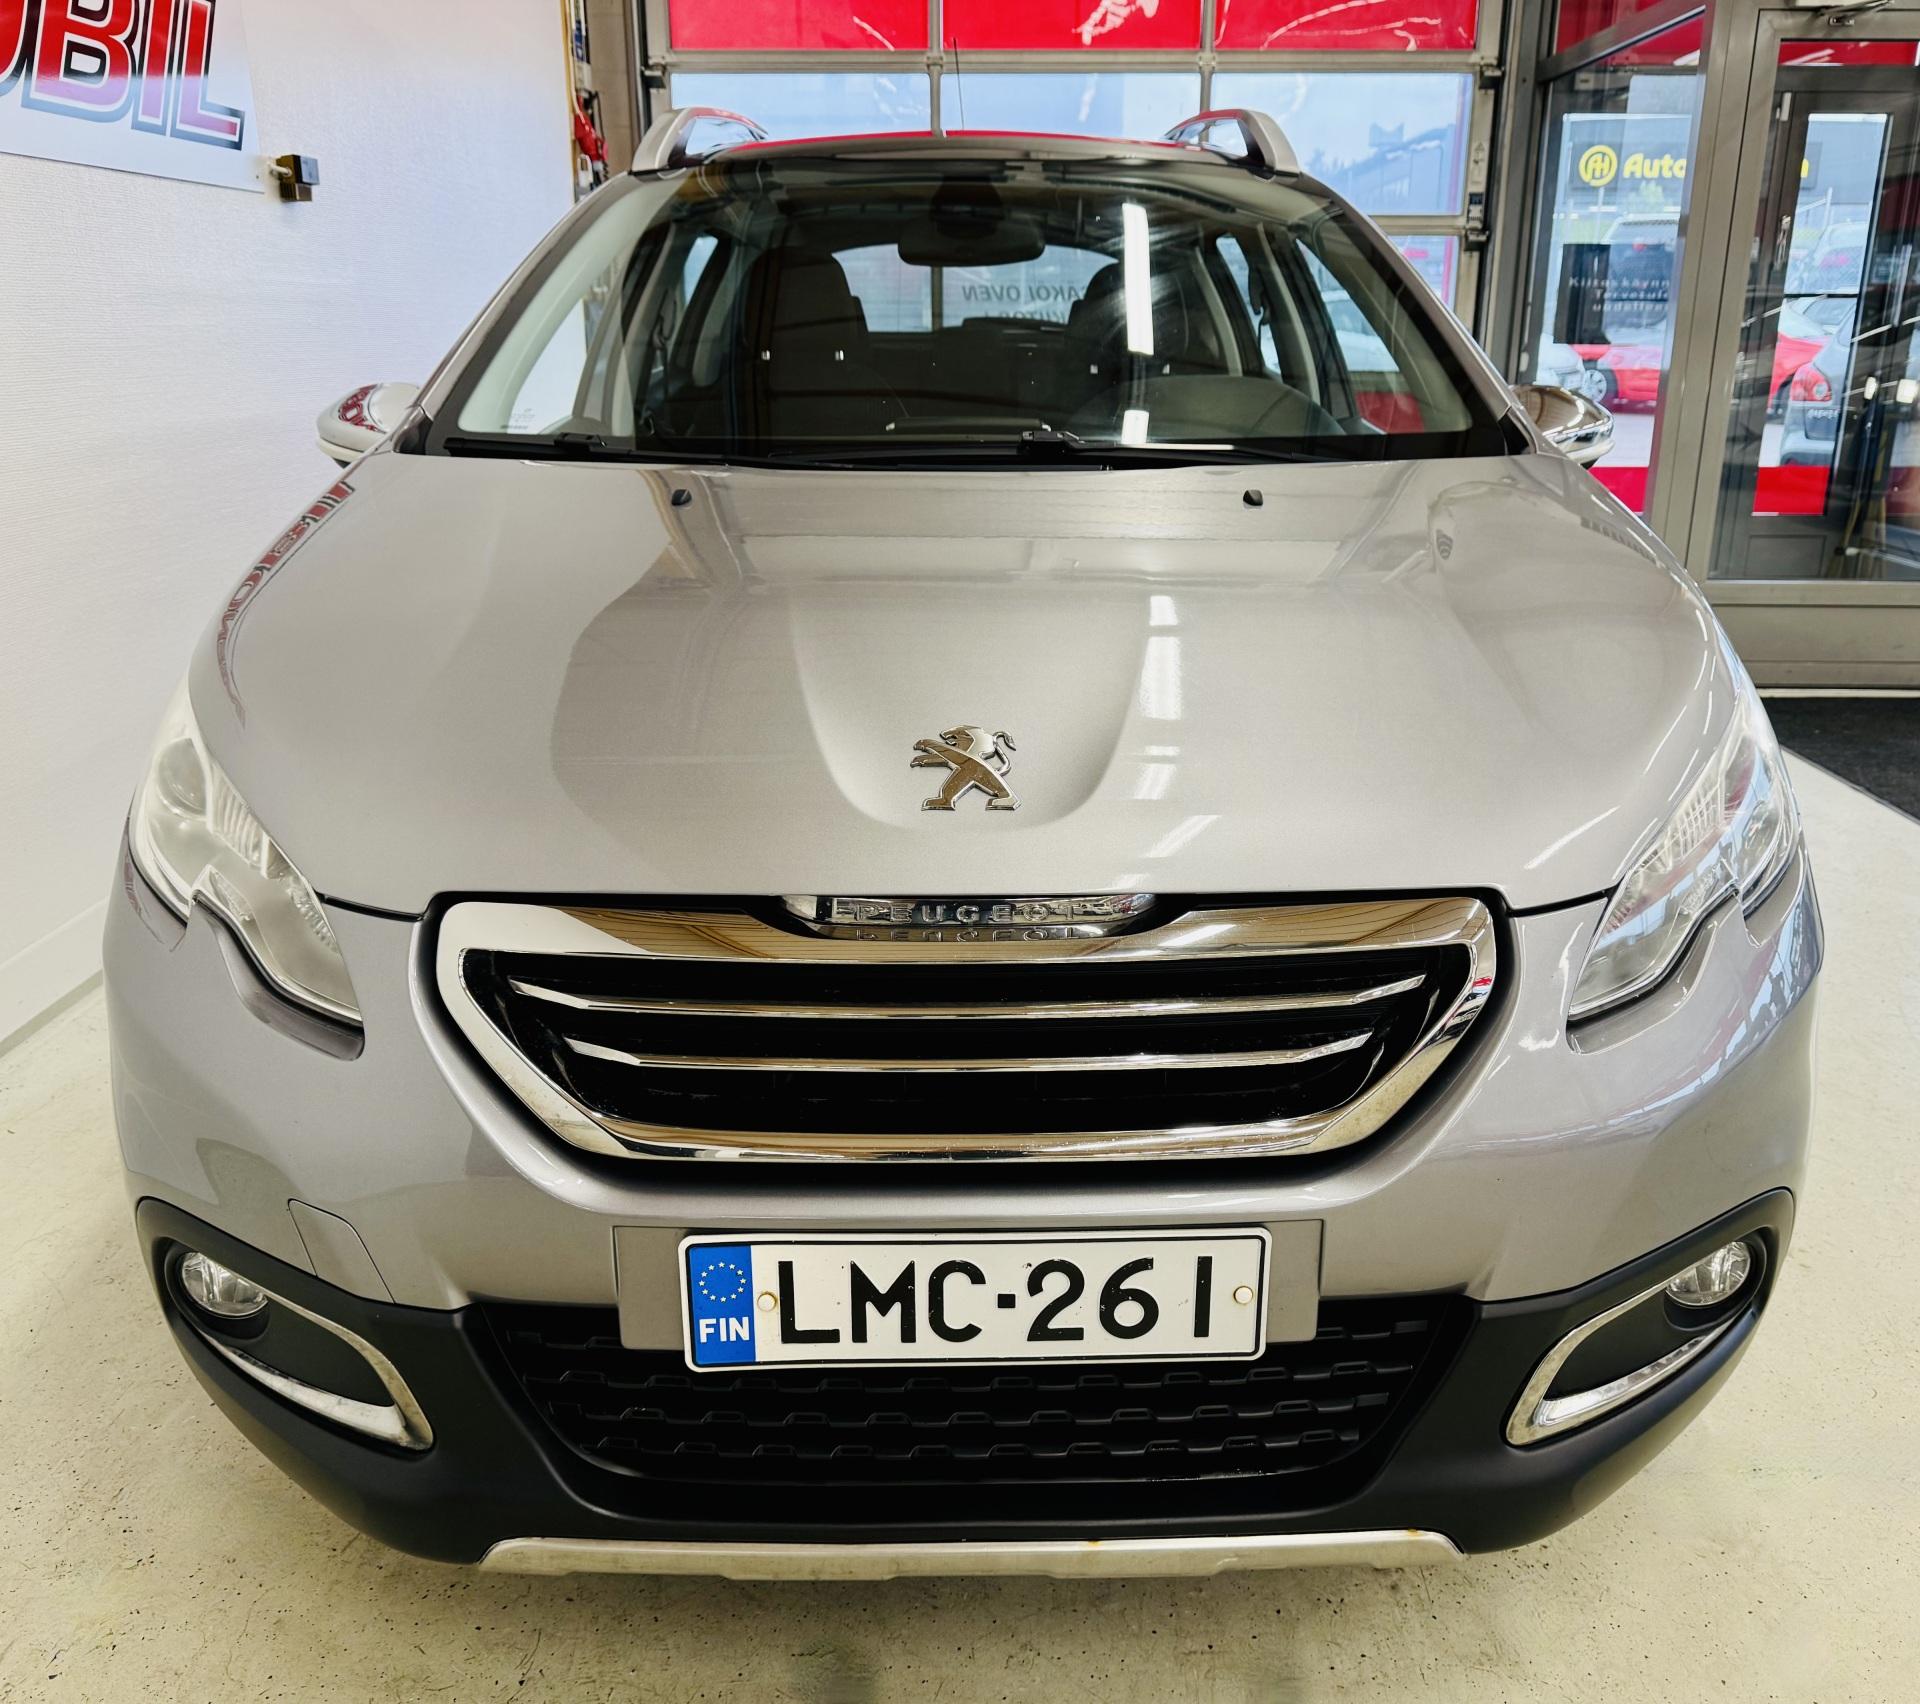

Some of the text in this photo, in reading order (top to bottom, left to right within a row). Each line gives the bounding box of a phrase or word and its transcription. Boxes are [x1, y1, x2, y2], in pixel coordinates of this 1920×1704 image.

[855, 904, 1077, 923] PEUGEOT
[778, 1256, 1213, 1344] LMC-261
[699, 1316, 750, 1344] FIN
